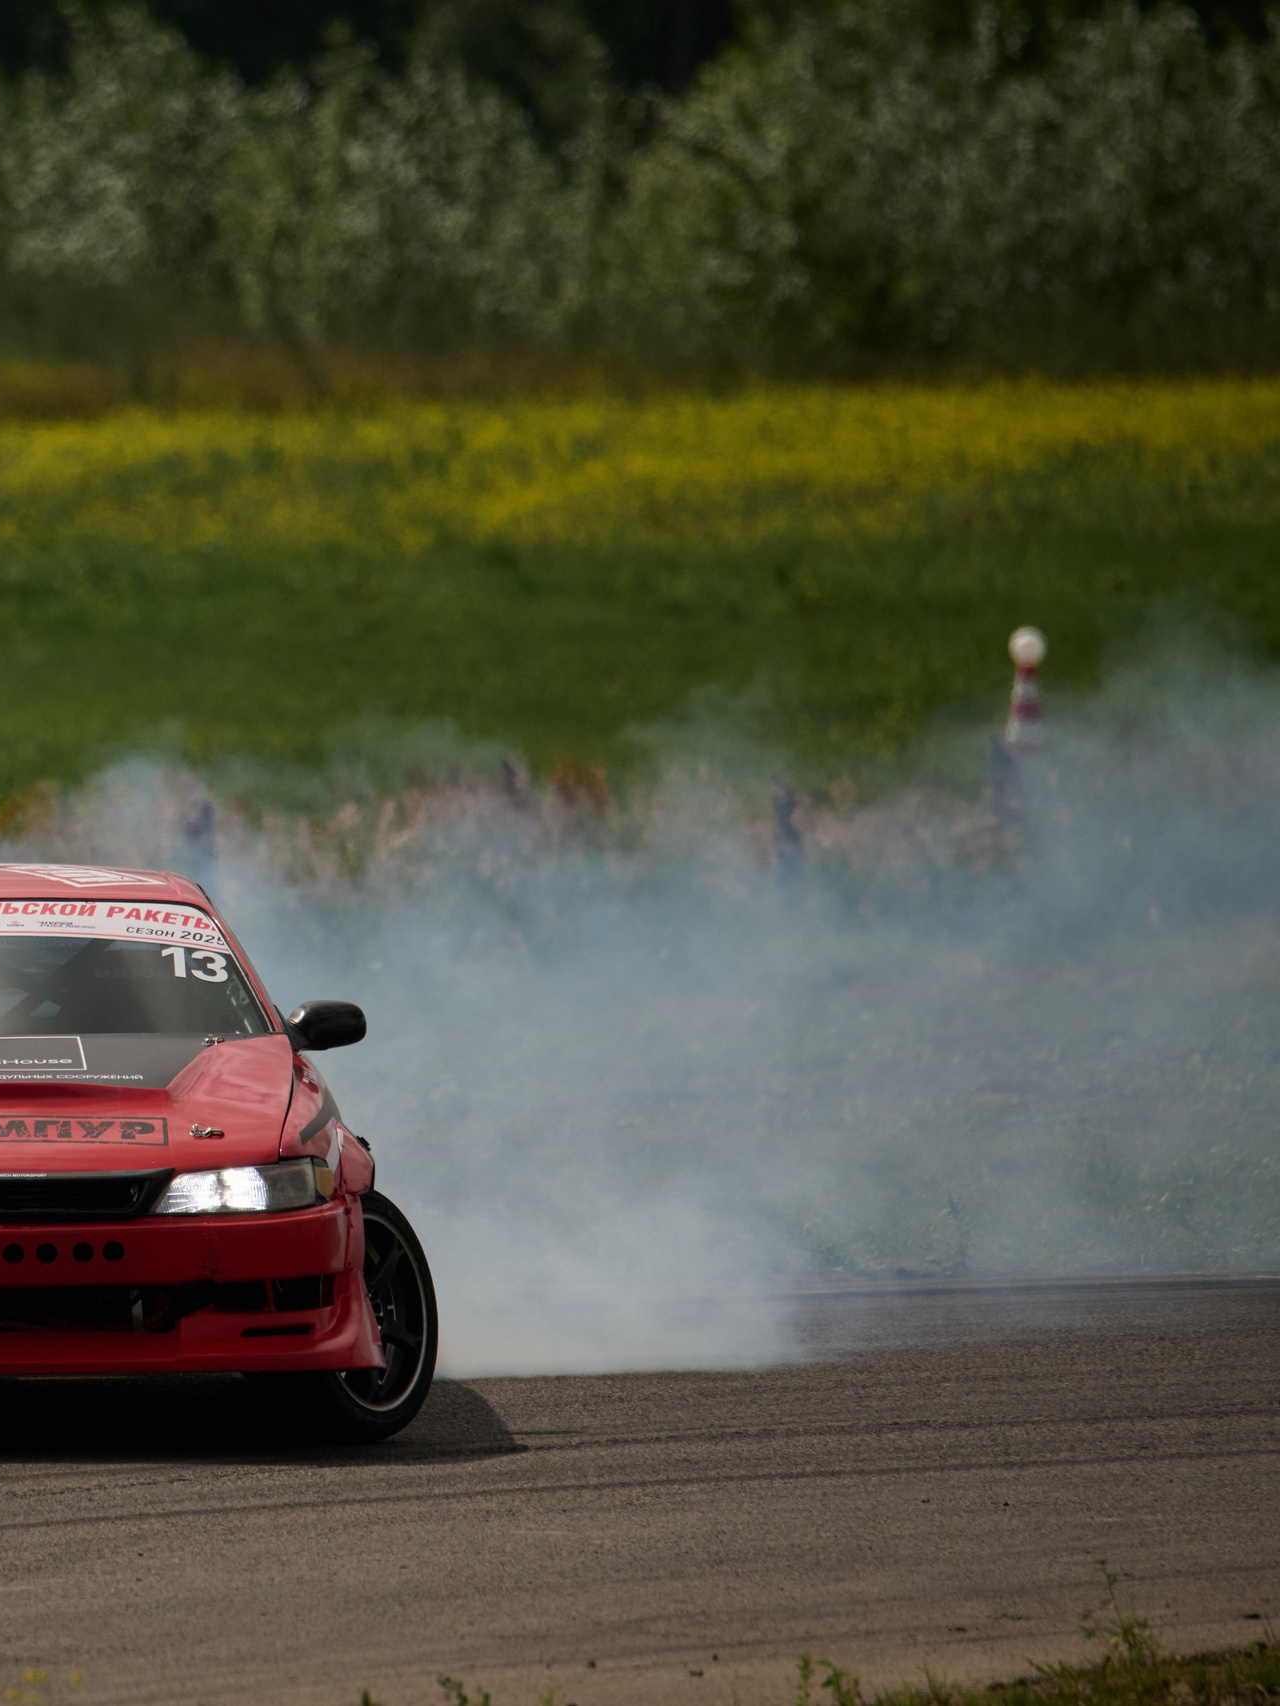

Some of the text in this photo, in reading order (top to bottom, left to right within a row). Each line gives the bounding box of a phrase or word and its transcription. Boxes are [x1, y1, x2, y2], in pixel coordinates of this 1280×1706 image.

[126, 926, 225, 946] СЕЗОН 2025
[161, 946, 229, 983] 13
